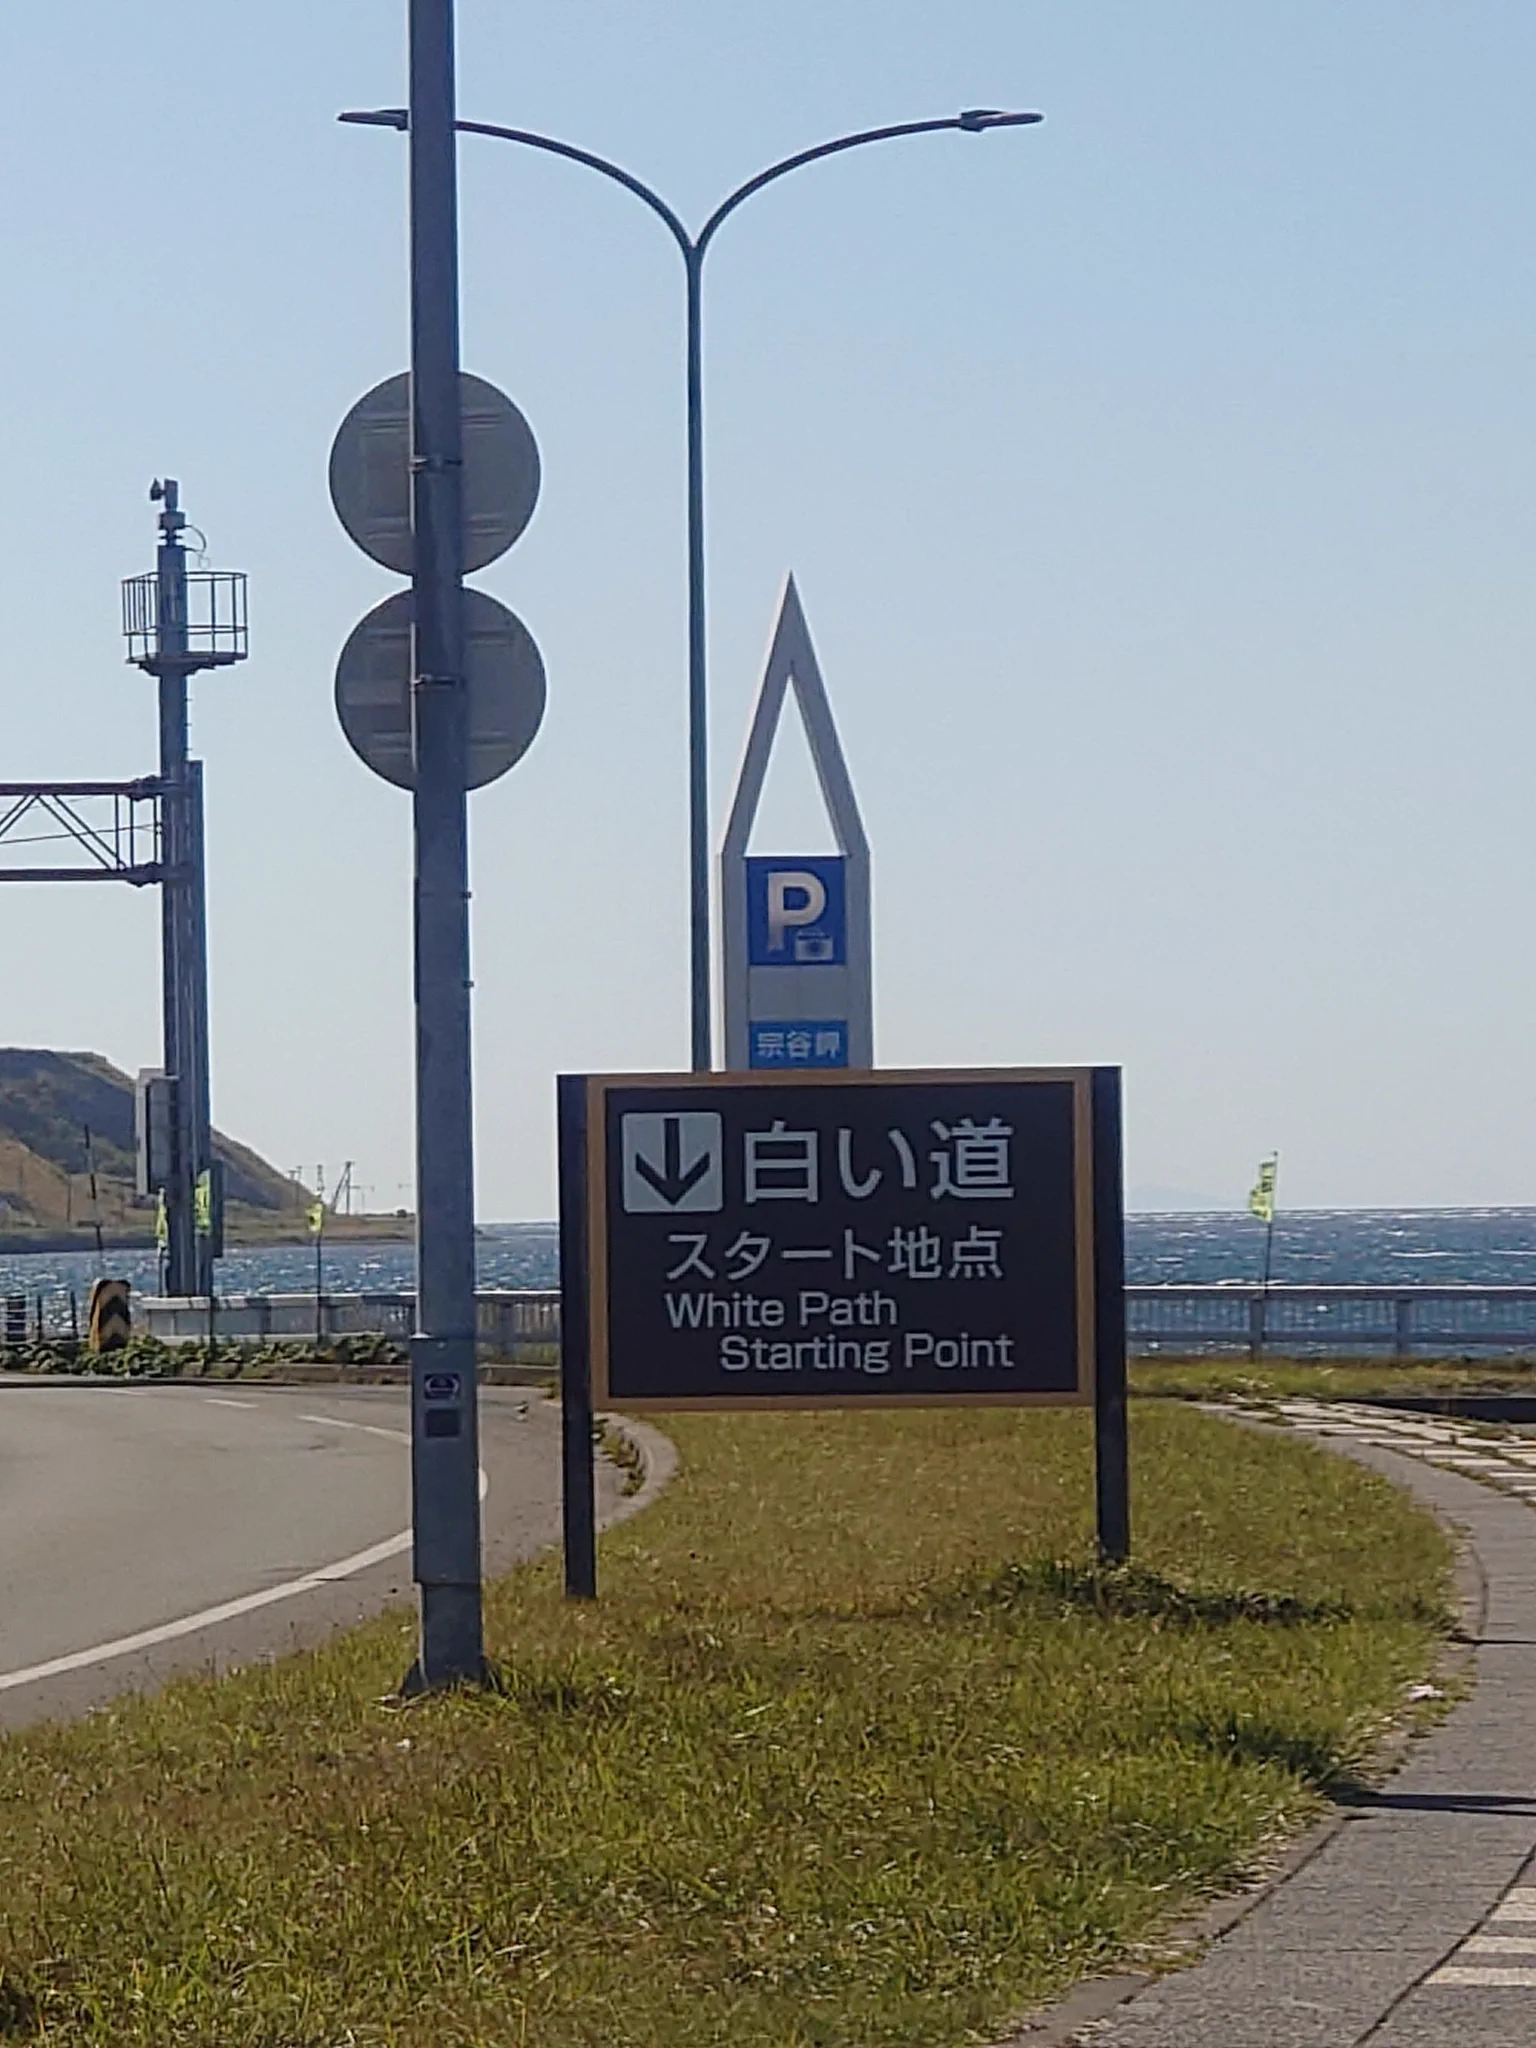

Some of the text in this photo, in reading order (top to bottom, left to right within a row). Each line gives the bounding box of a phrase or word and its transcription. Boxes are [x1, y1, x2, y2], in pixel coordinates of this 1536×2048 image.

[767, 871, 826, 952] P
[743, 1118, 1015, 1203] 白い道
[666, 1225, 1004, 1281] スタート地点
[664, 1290, 899, 1328] White Path
[720, 1332, 1015, 1374] Starting Point
